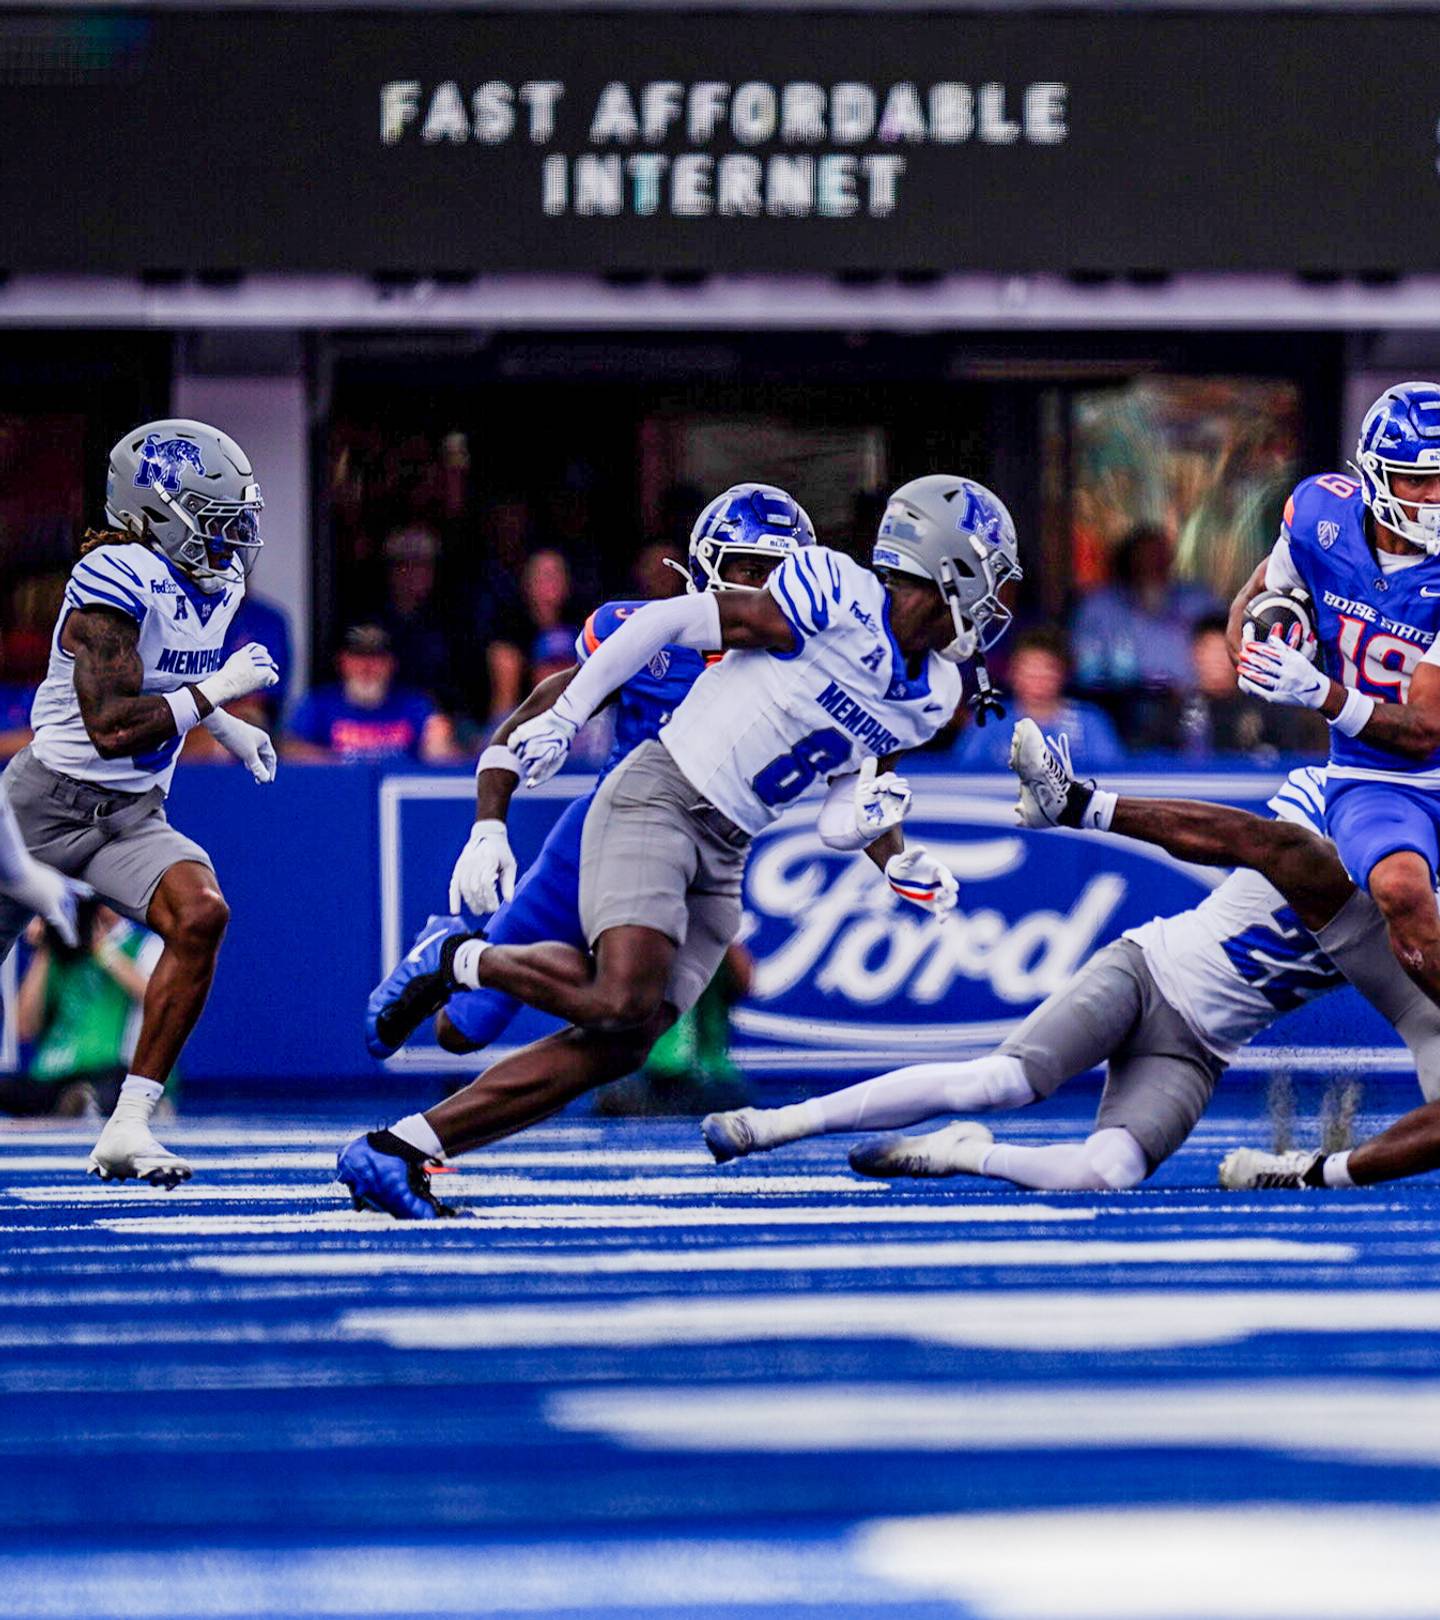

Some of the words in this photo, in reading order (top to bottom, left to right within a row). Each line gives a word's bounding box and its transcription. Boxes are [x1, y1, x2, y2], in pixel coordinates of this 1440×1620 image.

[380, 81, 564, 144] FAST
[590, 81, 1069, 144] AFFORDABLE
[542, 154, 905, 216] INTERNET
[1323, 590, 1377, 622] BOISE
[1380, 616, 1435, 645] STATE
[155, 648, 221, 674] MEMPH
[1337, 614, 1426, 704] 19
[815, 681, 901, 758] MEMPHIS
[751, 727, 853, 807] 8
[744, 829, 1128, 1006] Ford
